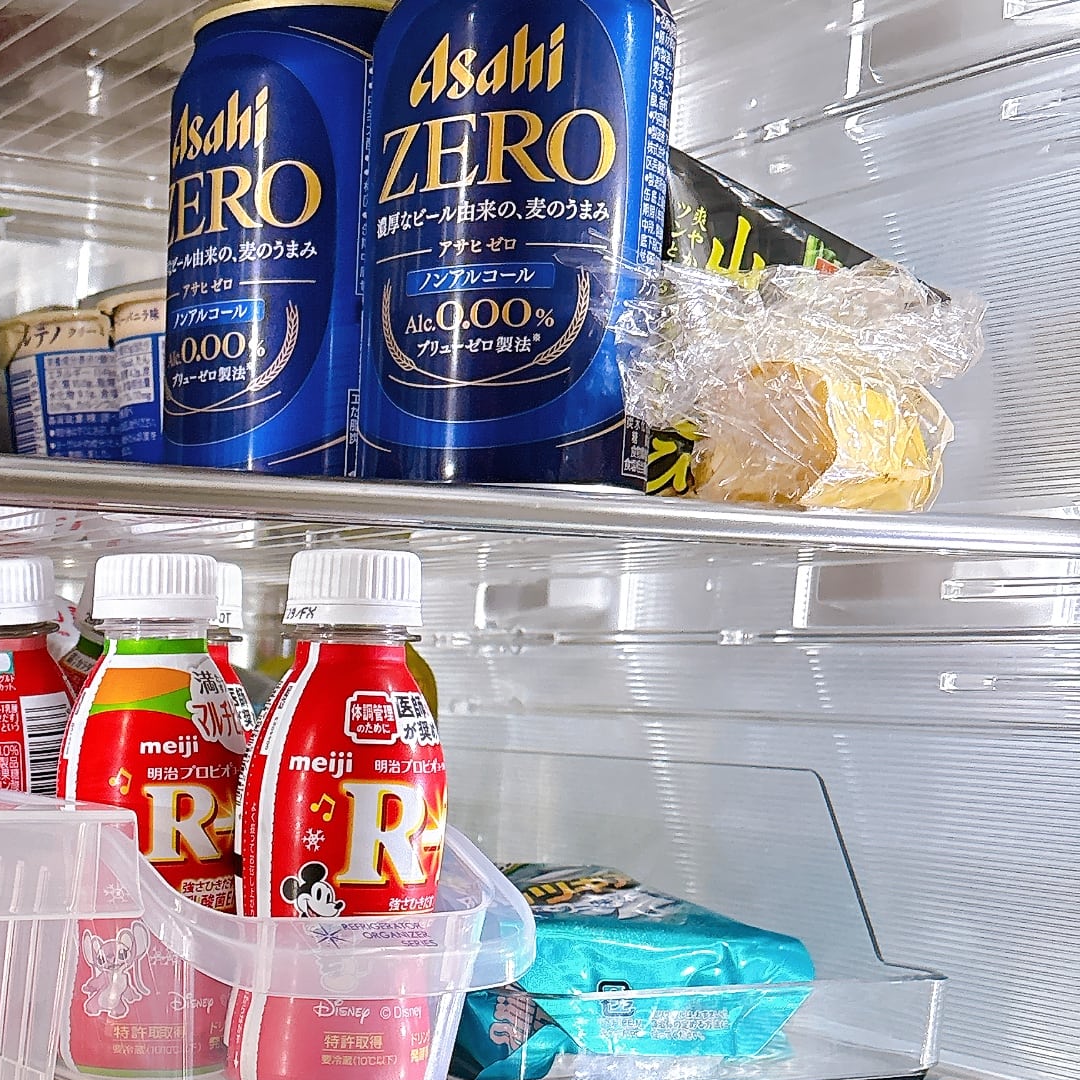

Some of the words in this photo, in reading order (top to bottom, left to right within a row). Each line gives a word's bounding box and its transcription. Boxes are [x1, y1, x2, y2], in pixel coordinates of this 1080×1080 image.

[409, 23, 565, 107] Asahi
[172, 86, 269, 168] Asahi
[379, 109, 616, 204] ZERO
[376, 197, 610, 239] 濃厚なビール由来の、麦のうまみ
[439, 239, 482, 258] アサヒ
[487, 238, 517, 252] ゼロ
[182, 283, 208, 300] アサヒ
[211, 278, 233, 293] ゼロ
[419, 267, 536, 292] ノンアルコール
[173, 304, 248, 329] ノンアルコール
[351, 703, 395, 721] 体調管理
[356, 723, 391, 734] のために
[140, 736, 199, 758] meiji
[289, 751, 353, 779] meiji
[362, 930, 430, 940] ORGANIZER
[324, 1034, 383, 1049] 特許取得
